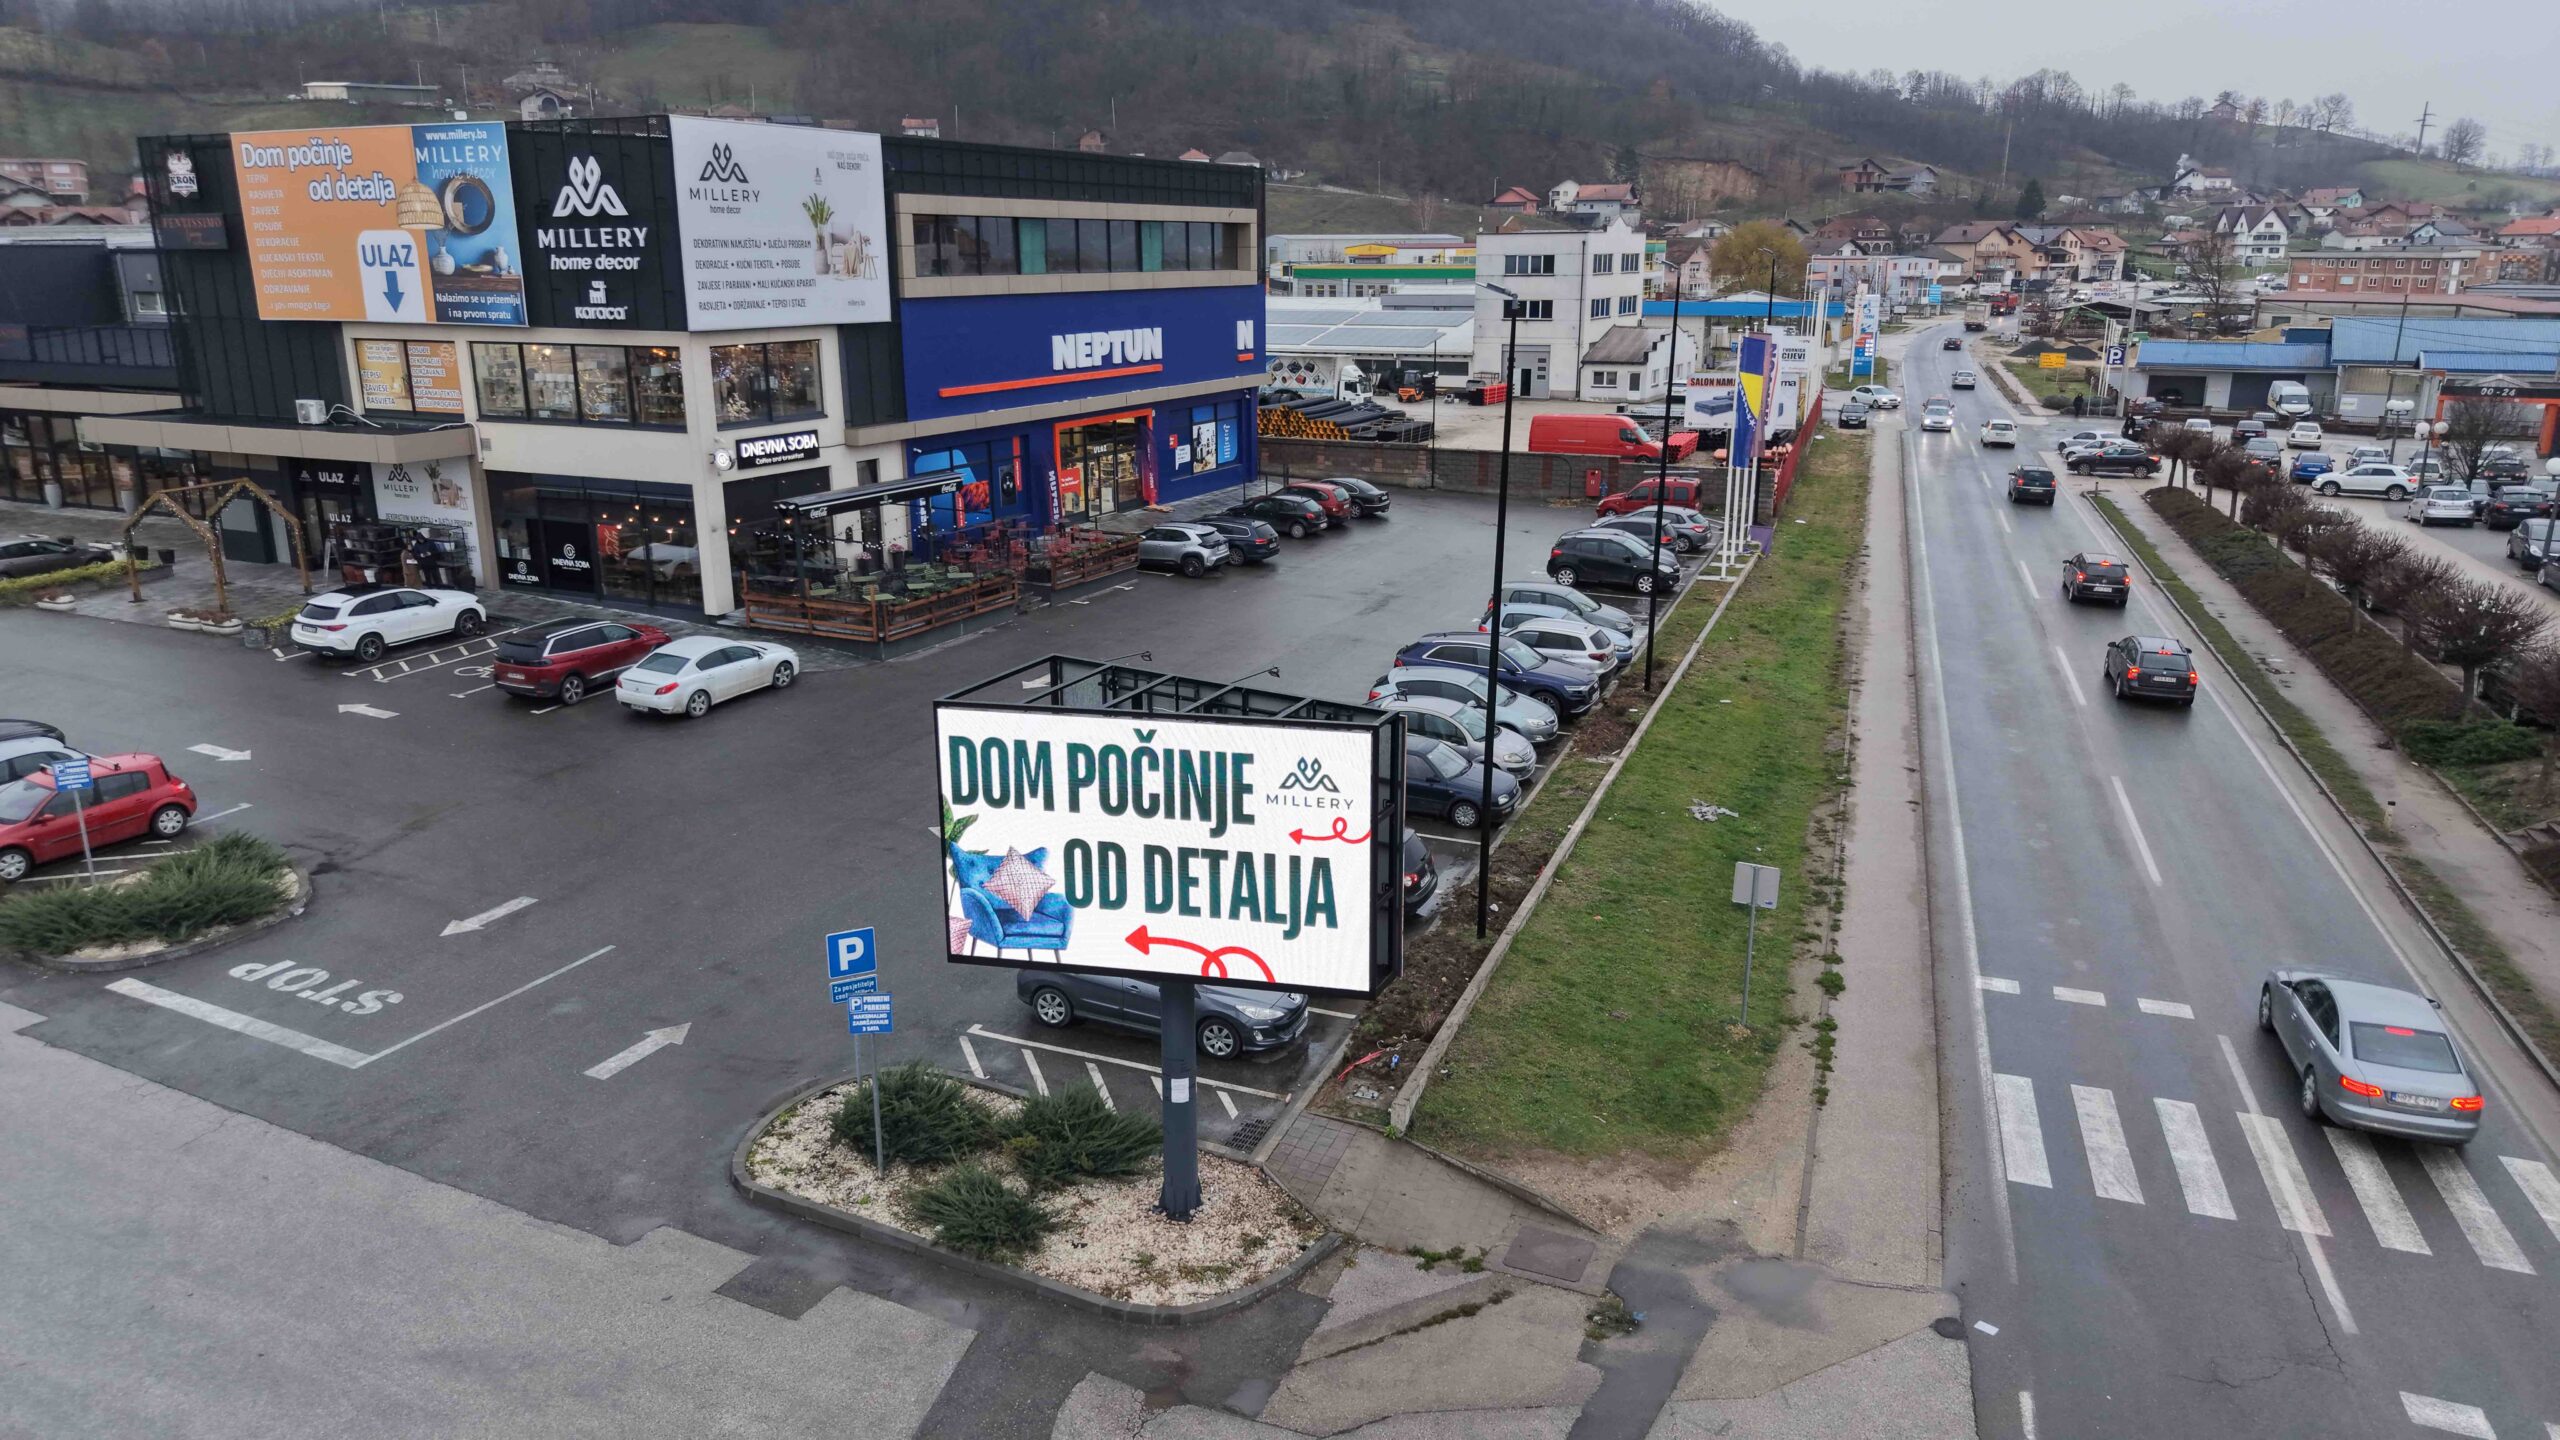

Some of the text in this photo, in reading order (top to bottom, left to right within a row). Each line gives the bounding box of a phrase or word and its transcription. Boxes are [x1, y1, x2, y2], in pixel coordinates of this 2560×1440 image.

[425, 128, 487, 141] www.millery.ba
[240, 136, 353, 173] Dom počinje
[415, 145, 502, 163] MILLERY
[170, 176, 195, 186] KRON
[309, 171, 397, 206] od detalja
[689, 187, 760, 203] MILLERY
[709, 204, 741, 214] home decor
[537, 227, 648, 248] MILLERY
[693, 239, 729, 249] DEKORATIVNI
[361, 244, 415, 268] ULAZ
[550, 254, 641, 270] home decor
[436, 293, 469, 303] Nalazimo
[487, 294, 521, 305] prizemlju
[699, 301, 727, 310] RASVJETA
[463, 311, 487, 320] prvom
[488, 311, 511, 320] spratu
[575, 306, 628, 320] karaca
[1236, 320, 1254, 350] N
[1051, 327, 1163, 370] NEPTUN
[1781, 352, 1806, 360] CIJEVI
[1690, 378, 1715, 387] SALON
[2481, 388, 2494, 396] 00
[2502, 388, 2516, 396] 24
[741, 434, 818, 458] DNEVNA SOBA
[318, 471, 344, 484] ULAZ
[383, 483, 419, 493] MILLERY
[552, 557, 591, 569] DNEVNA SOBA
[949, 727, 1255, 838] DOM POČINJE
[1266, 793, 1354, 811] MILLERY
[1063, 837, 1338, 940] OD DETALJA
[838, 936, 864, 971] P
[228, 959, 404, 1015] STOP
